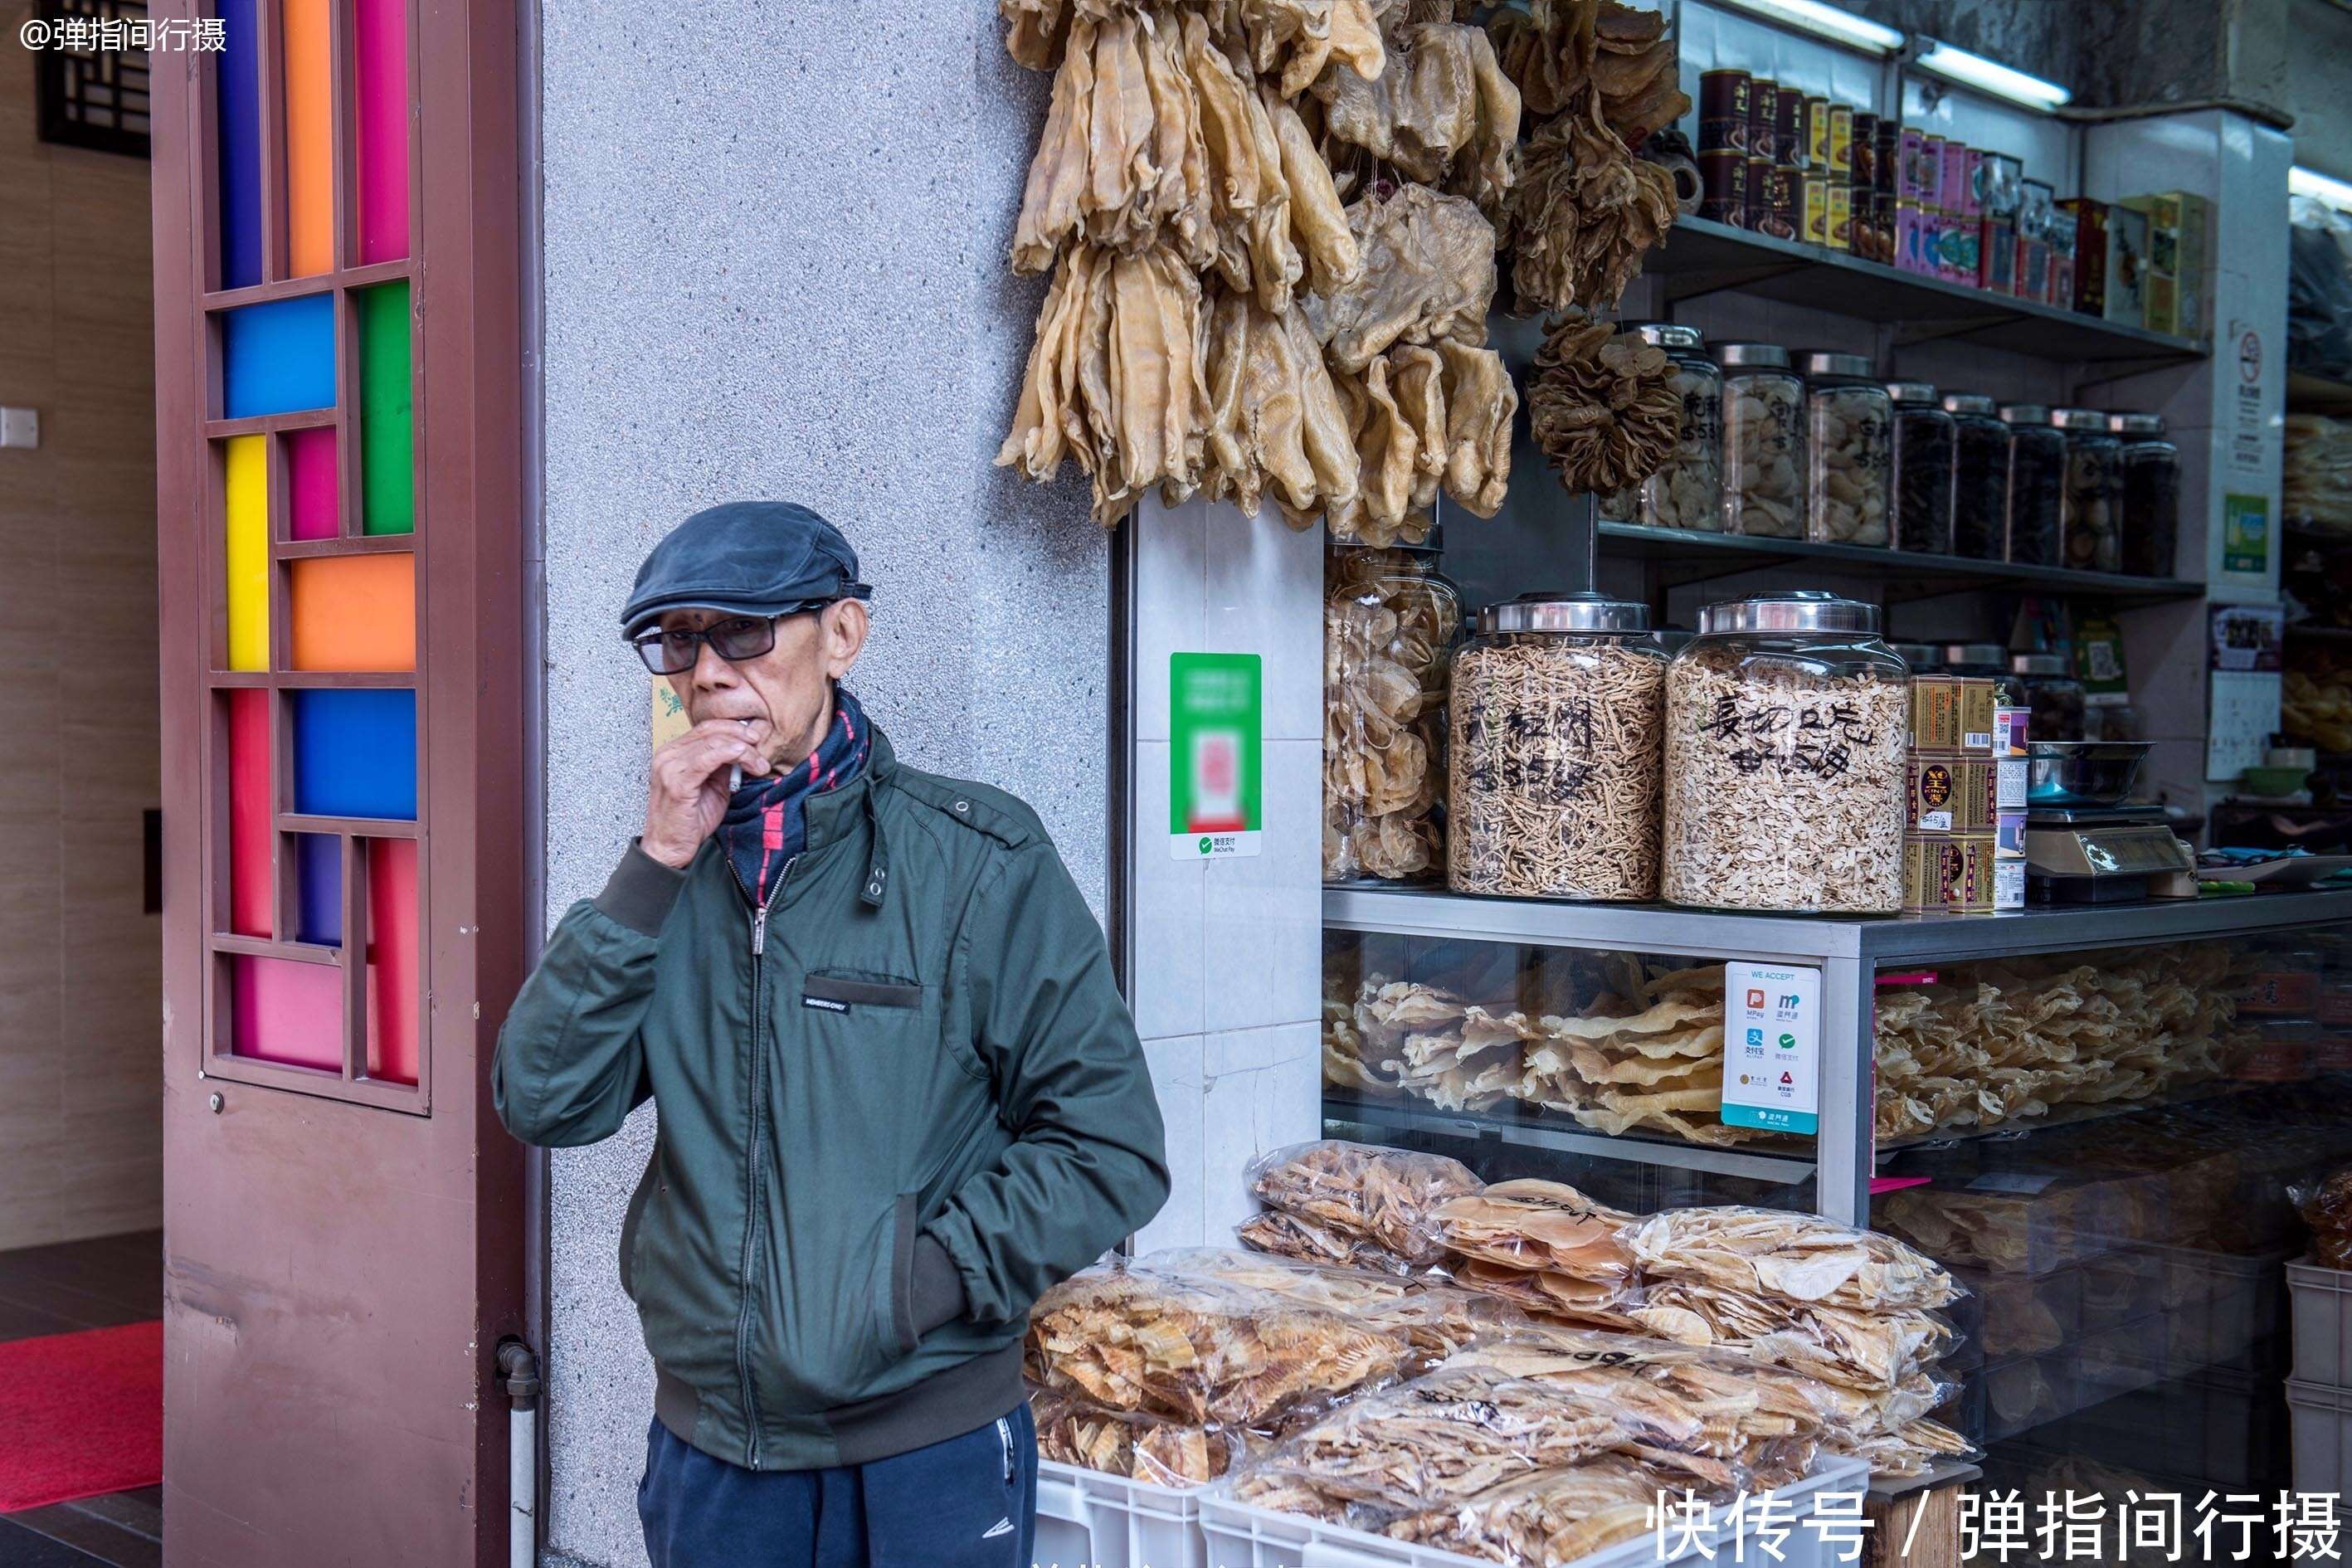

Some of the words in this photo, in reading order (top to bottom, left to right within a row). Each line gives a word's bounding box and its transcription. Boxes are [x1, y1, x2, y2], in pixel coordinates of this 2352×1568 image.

[1927, 771, 1947, 780] XO
[1928, 780, 1947, 789] 王
[1765, 972, 1795, 981] ACCEPT
[1746, 1010, 1765, 1018] MPay
[1746, 1047, 1765, 1055] 支付宝
